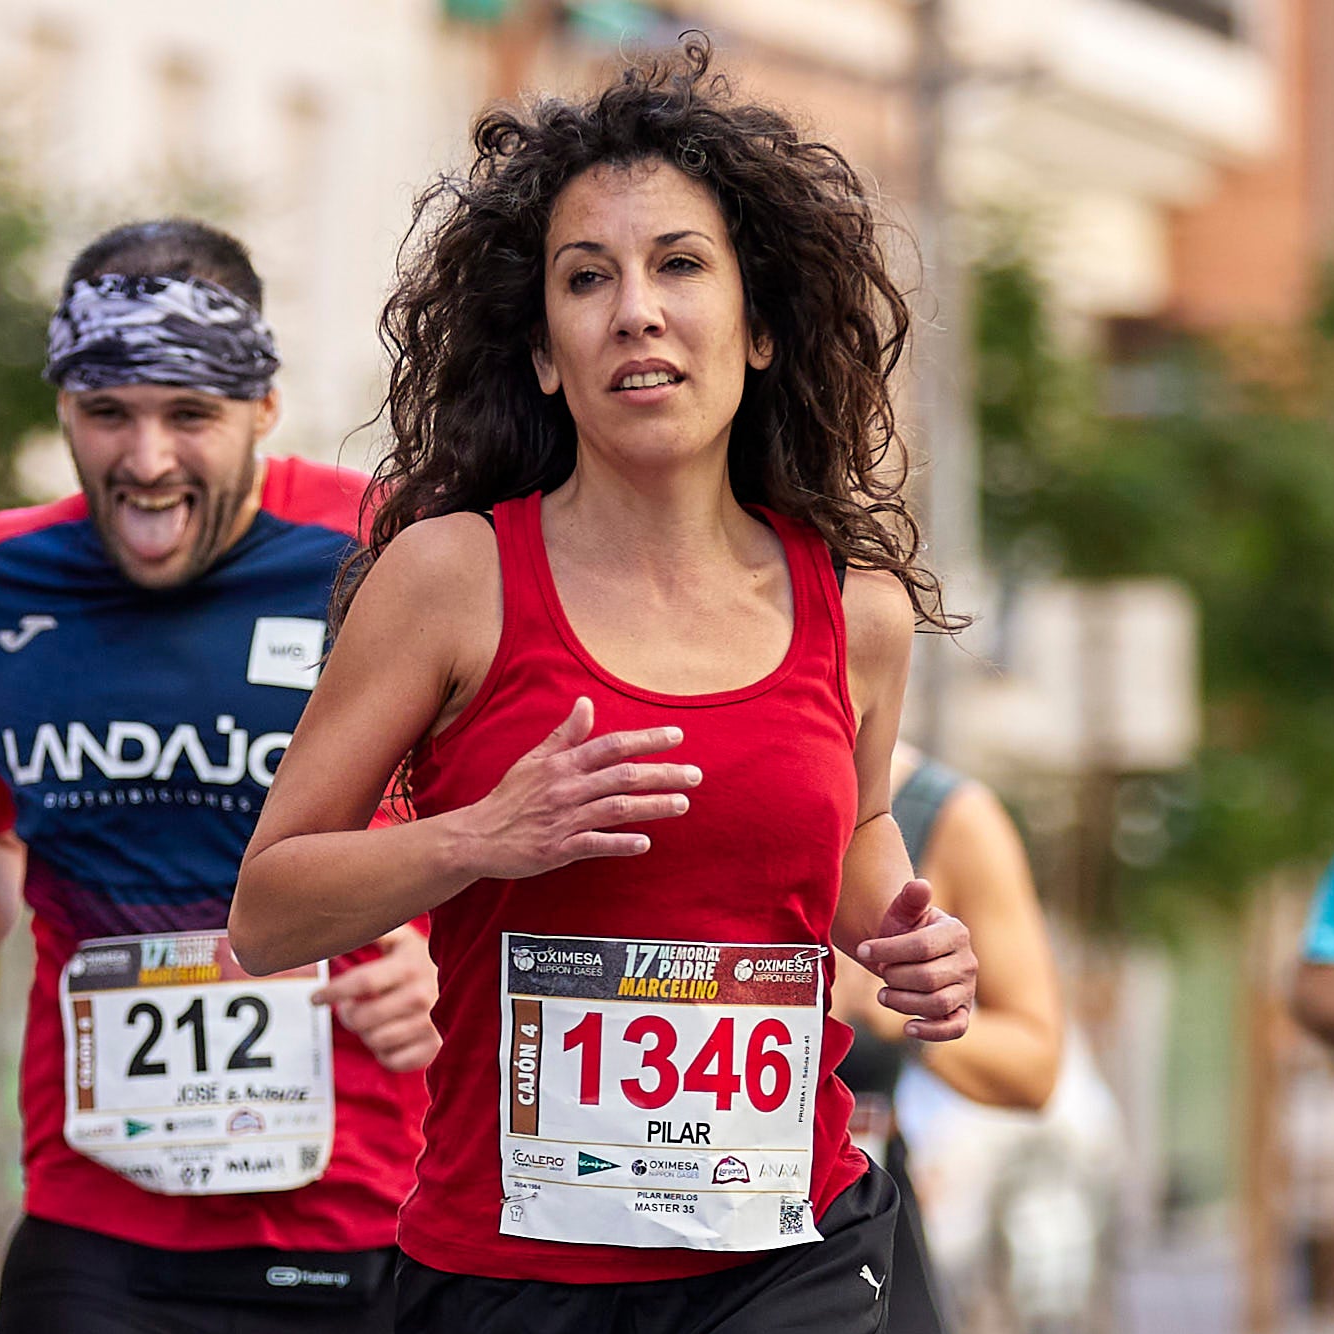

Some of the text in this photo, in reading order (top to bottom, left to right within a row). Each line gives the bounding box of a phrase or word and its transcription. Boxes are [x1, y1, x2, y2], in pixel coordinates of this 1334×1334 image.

[536, 951, 603, 966] OXIMESA
[624, 944, 660, 978] 17
[657, 945, 720, 962] MEMORIAL
[536, 965, 603, 977] NIPPON GASES
[657, 960, 717, 981] PADRE
[755, 959, 813, 973] OXIMESA
[753, 973, 813, 984] NIPPON GASES
[617, 977, 719, 1000] MARCELINO
[126, 995, 273, 1078] 212
[513, 1023, 539, 1106] CAJÓN 4
[563, 1011, 793, 1114] 1346
[647, 1120, 711, 1145] PILAR
[516, 1152, 564, 1167] CALERO
[649, 1160, 700, 1171] OXIMESA
[758, 1163, 801, 1178] ANAYA
[637, 1191, 698, 1201] PILAR MERLOS
[634, 1203, 696, 1214] MASTER 35
